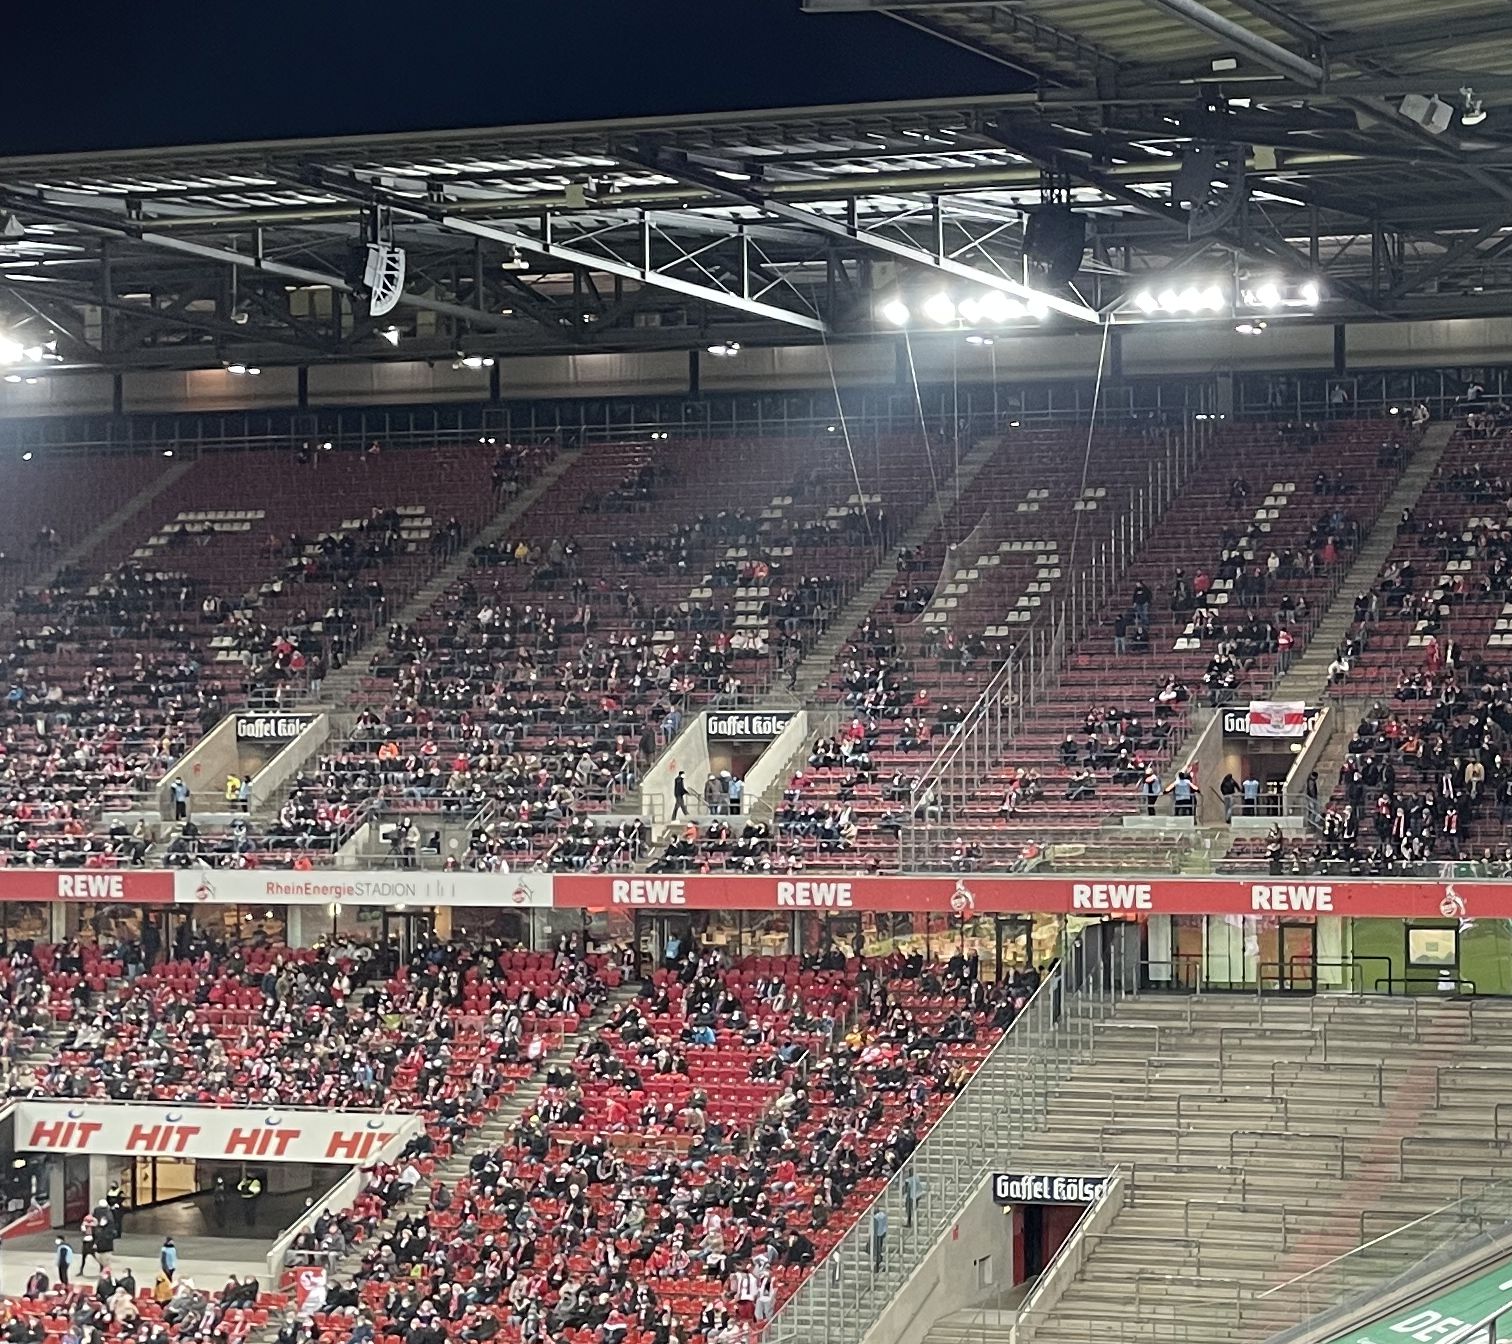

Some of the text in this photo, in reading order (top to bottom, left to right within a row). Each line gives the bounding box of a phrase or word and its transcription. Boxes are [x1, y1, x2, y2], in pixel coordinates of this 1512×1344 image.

[238, 718, 277, 738] Gaffel
[708, 715, 790, 736] Gaffel Köls
[57, 874, 124, 898] REWE
[266, 881, 416, 899] RheinEnergieSTADION
[612, 880, 686, 906] REWE
[777, 882, 852, 908] REWE
[1072, 884, 1153, 910] REWE
[1251, 886, 1333, 913] REWE
[29, 1120, 102, 1149] HIT
[126, 1123, 200, 1152] HIT
[224, 1127, 301, 1157] HIT
[997, 1175, 1051, 1200] Gaffel
